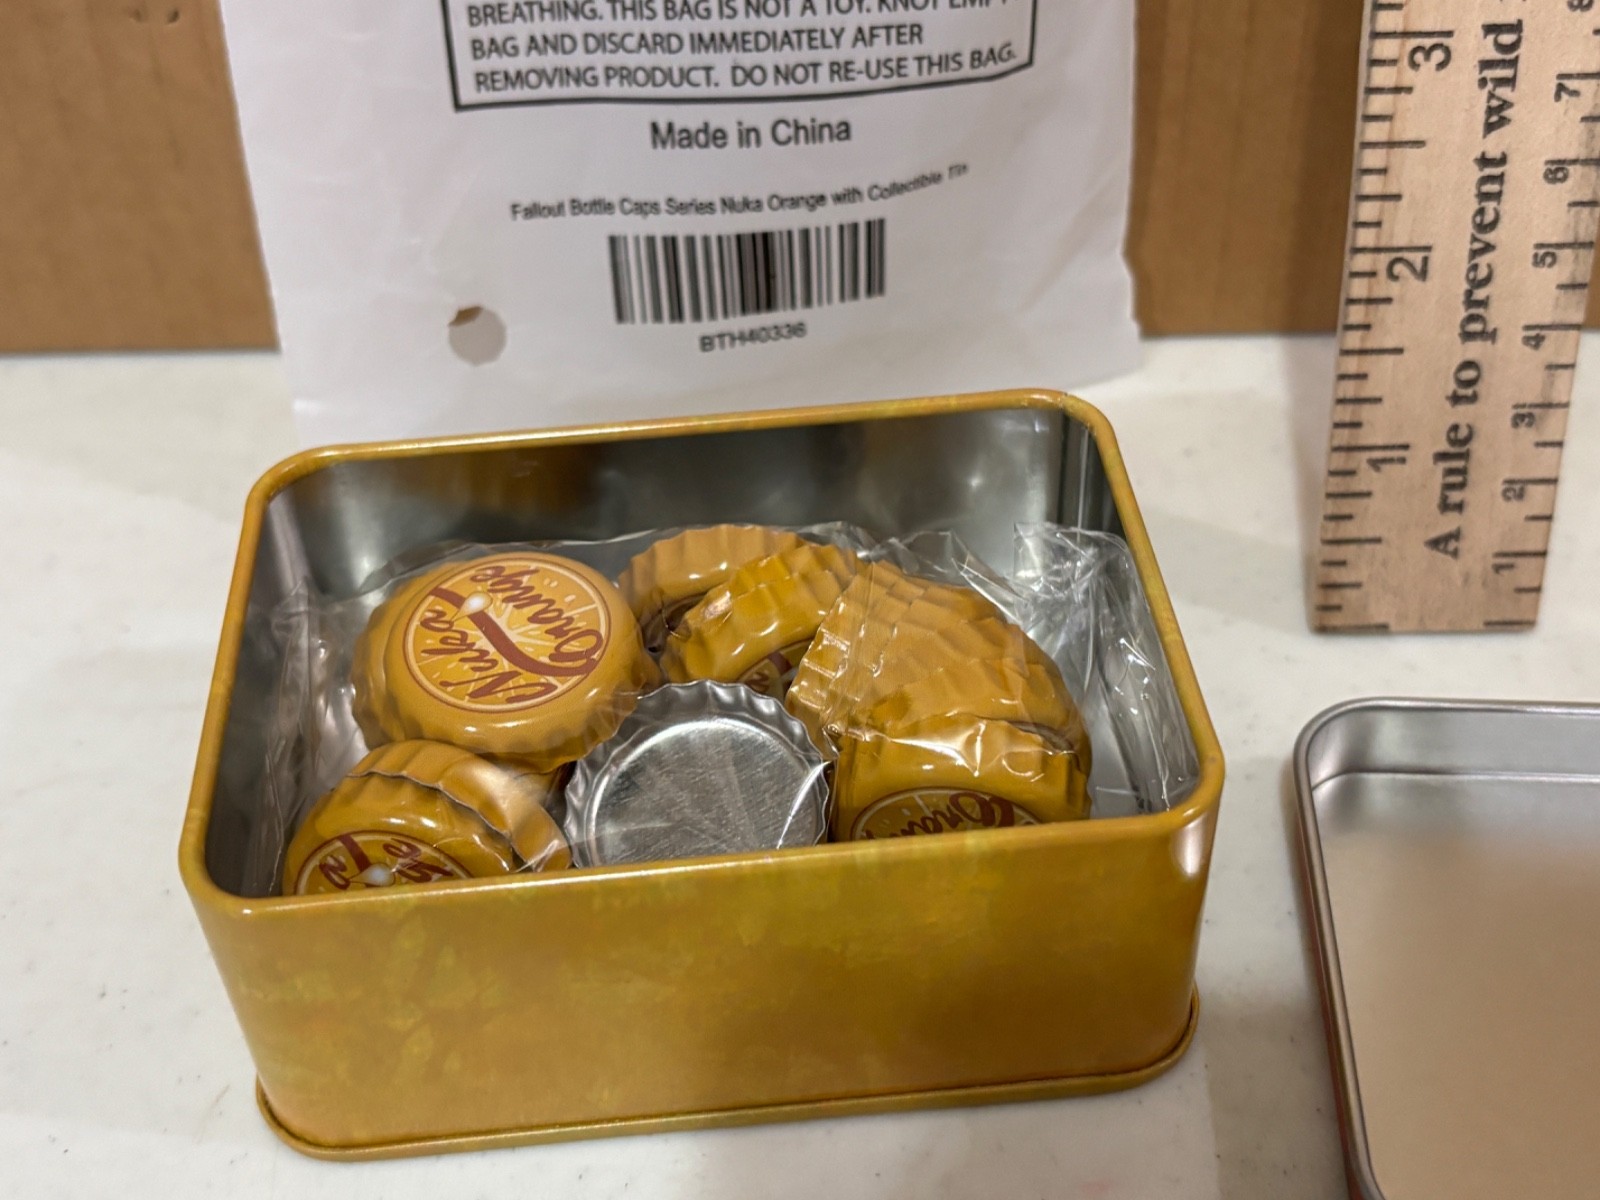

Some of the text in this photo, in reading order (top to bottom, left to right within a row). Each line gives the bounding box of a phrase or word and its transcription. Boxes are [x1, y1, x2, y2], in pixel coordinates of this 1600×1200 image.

[468, 0, 603, 27] BREATHING.
[607, 0, 657, 20] THIS
[663, 0, 712, 21] BAG
[719, 0, 737, 19] IS
[744, 0, 791, 19] NOT
[800, 0, 817, 16] A
[471, 23, 923, 60] BAG AND DISCARD IMMEDIATELY AFTER
[475, 42, 1016, 93] REMOVING PRODUCT. DO NOT RE-USE THIS BAG.
[1407, 42, 1452, 72] 3
[1554, 82, 1581, 102] 7
[650, 117, 852, 149] Made in China
[1543, 166, 1570, 185] 6
[510, 202, 566, 220] Fallout
[570, 198, 616, 217] Bottle
[619, 198, 661, 219] Caps
[665, 197, 717, 215] Series
[721, 197, 763, 214] Nuka
[767, 193, 827, 212] Orange
[831, 187, 864, 206] with
[868, 171, 943, 201] Collectible
[1386, 255, 1429, 282] 2
[1531, 250, 1557, 269] 5
[1424, 19, 1524, 560] A rule to prevent wild
[1521, 332, 1547, 351] 4
[1511, 411, 1536, 429] 3
[1366, 456, 1407, 472] 1
[1501, 485, 1526, 502] 2
[1491, 562, 1515, 575] 1
[470, 566, 604, 663] Orange
[420, 609, 559, 704] Nuka
